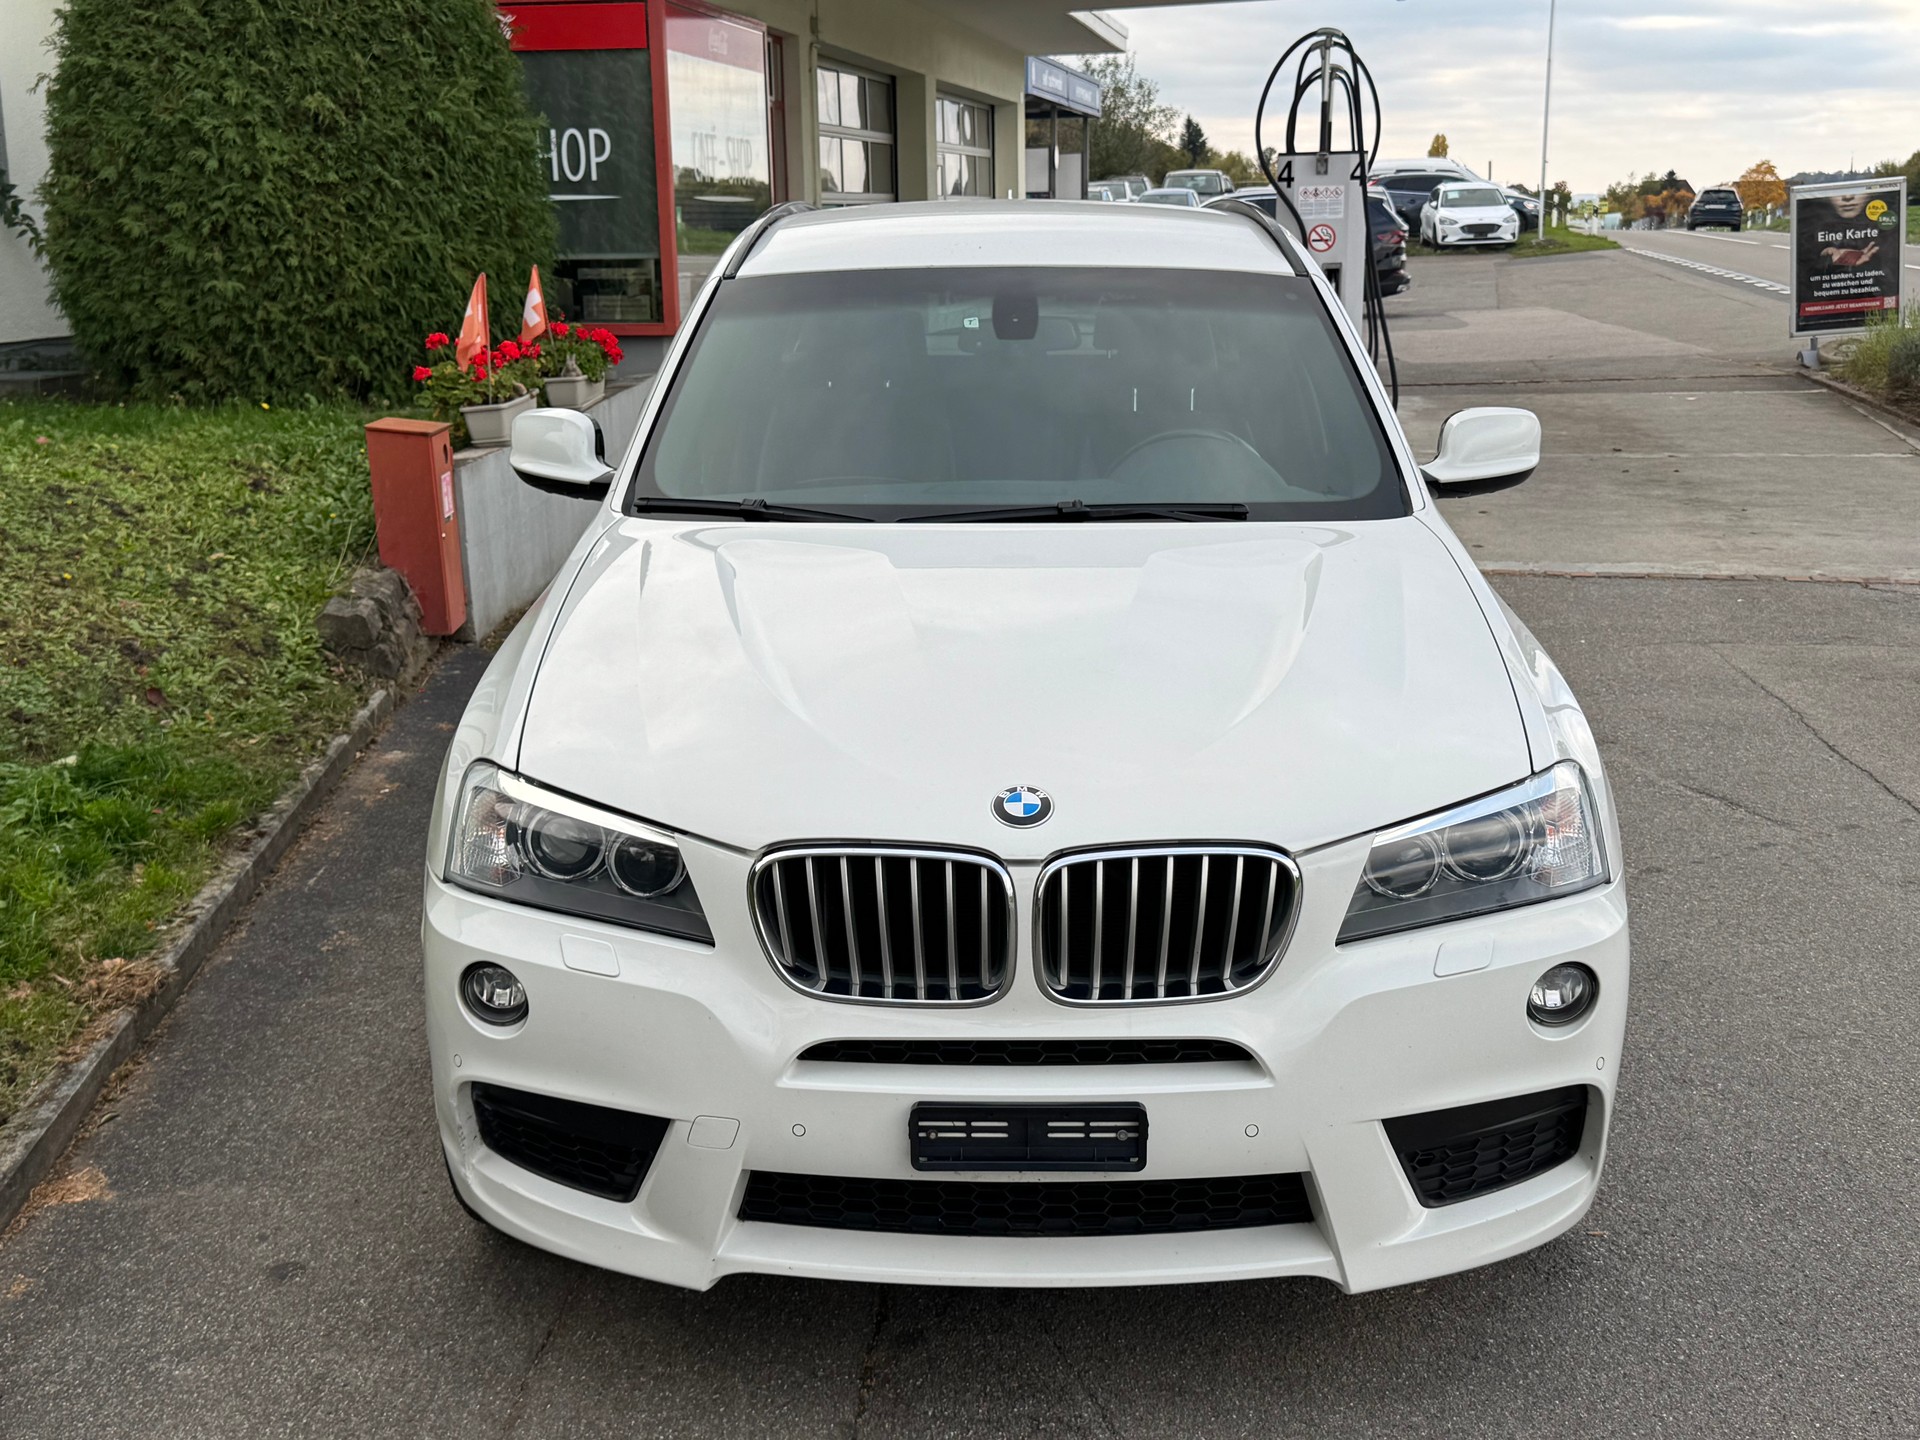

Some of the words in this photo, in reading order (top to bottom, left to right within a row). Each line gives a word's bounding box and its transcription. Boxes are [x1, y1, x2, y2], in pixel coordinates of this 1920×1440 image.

[536, 127, 612, 183] HOP
[1277, 160, 1295, 189] 4
[1817, 231, 1843, 242] Eine
[1846, 228, 1879, 240] Karte
[1831, 280, 1860, 288] waschen
[1813, 289, 1840, 297] bequem
[998, 786, 1047, 799] BMW
